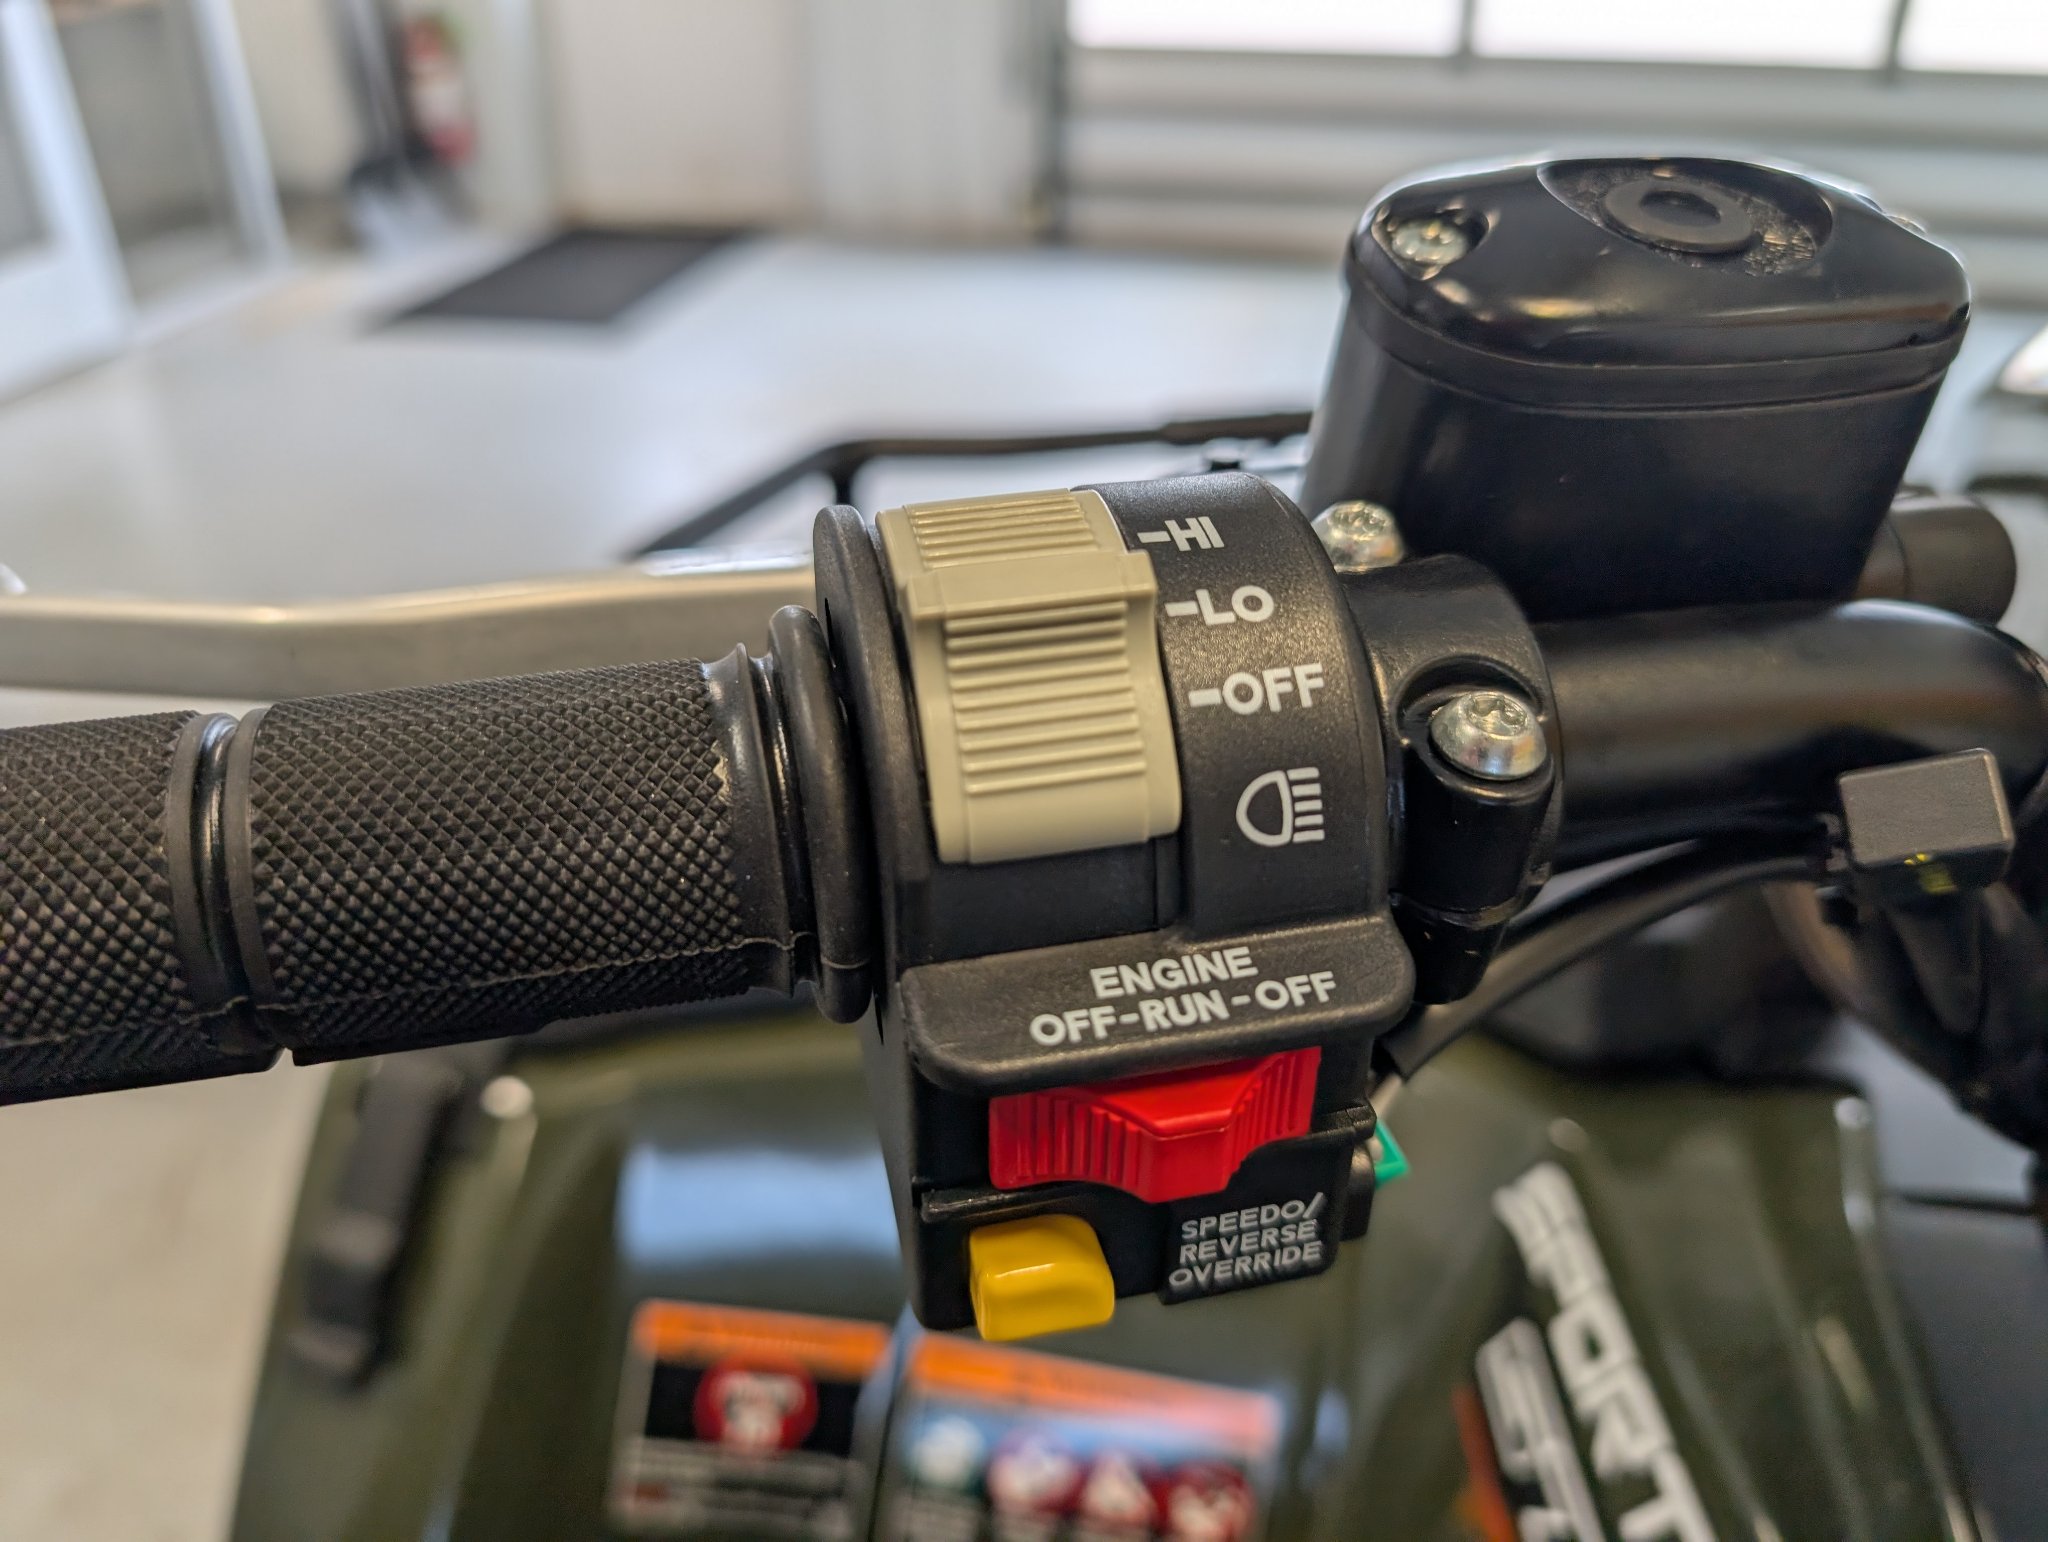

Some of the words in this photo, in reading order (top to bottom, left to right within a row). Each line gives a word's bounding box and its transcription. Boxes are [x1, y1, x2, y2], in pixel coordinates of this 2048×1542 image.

[1088, 945, 1258, 999] ENGINE
[1179, 1219, 1319, 1265] REVERSE
[1181, 1192, 1325, 1241] SPEEDO/
[1168, 1239, 1324, 1293] OVERRIDE
